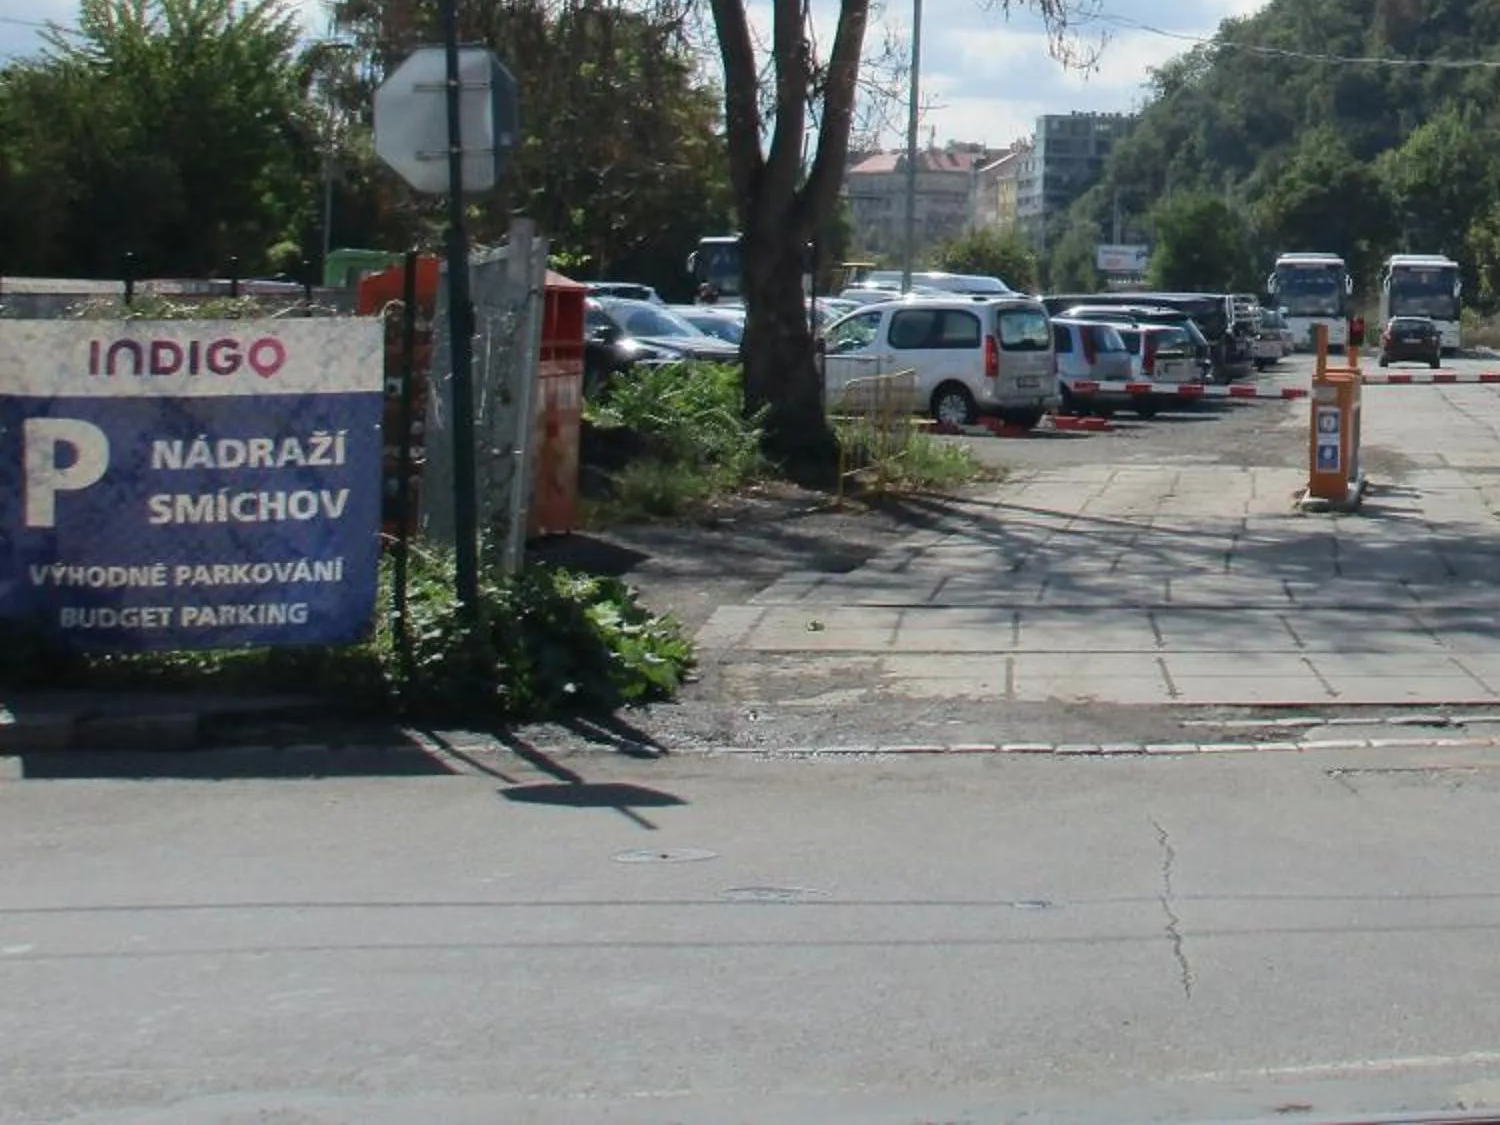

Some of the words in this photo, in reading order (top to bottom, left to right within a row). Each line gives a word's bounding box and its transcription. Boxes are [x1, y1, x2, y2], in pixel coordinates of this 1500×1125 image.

[89, 337, 287, 379] INDIGO
[152, 429, 349, 470] NÁDRAŽÍ
[23, 416, 110, 528] P
[148, 487, 350, 525] SMÍCHOV
[30, 561, 168, 587] VÝHODNÉ
[174, 556, 344, 586] PARKOVÁNÍ
[60, 606, 173, 629] BUDGET
[181, 602, 308, 628] PARKING
